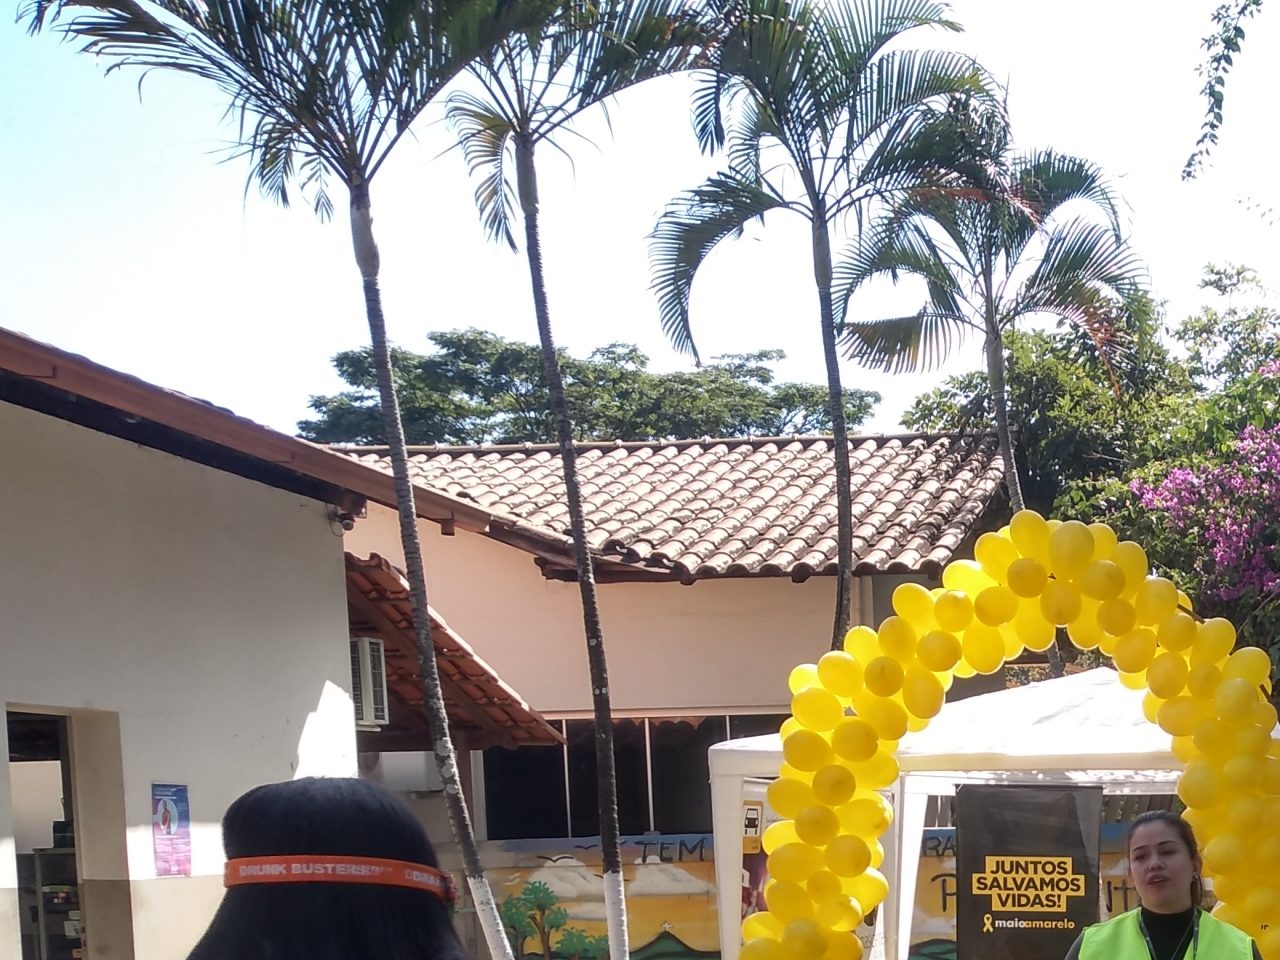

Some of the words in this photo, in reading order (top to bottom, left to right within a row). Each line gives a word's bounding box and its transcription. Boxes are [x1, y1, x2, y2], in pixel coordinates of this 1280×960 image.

[634, 836, 707, 865] TEM
[239, 863, 287, 878] DRUNK
[990, 860, 1068, 875] JUNTOS
[976, 876, 1081, 892] SALVAMOS
[996, 893, 1062, 908] VIDAS!
[994, 917, 1075, 930] maioamarelo
